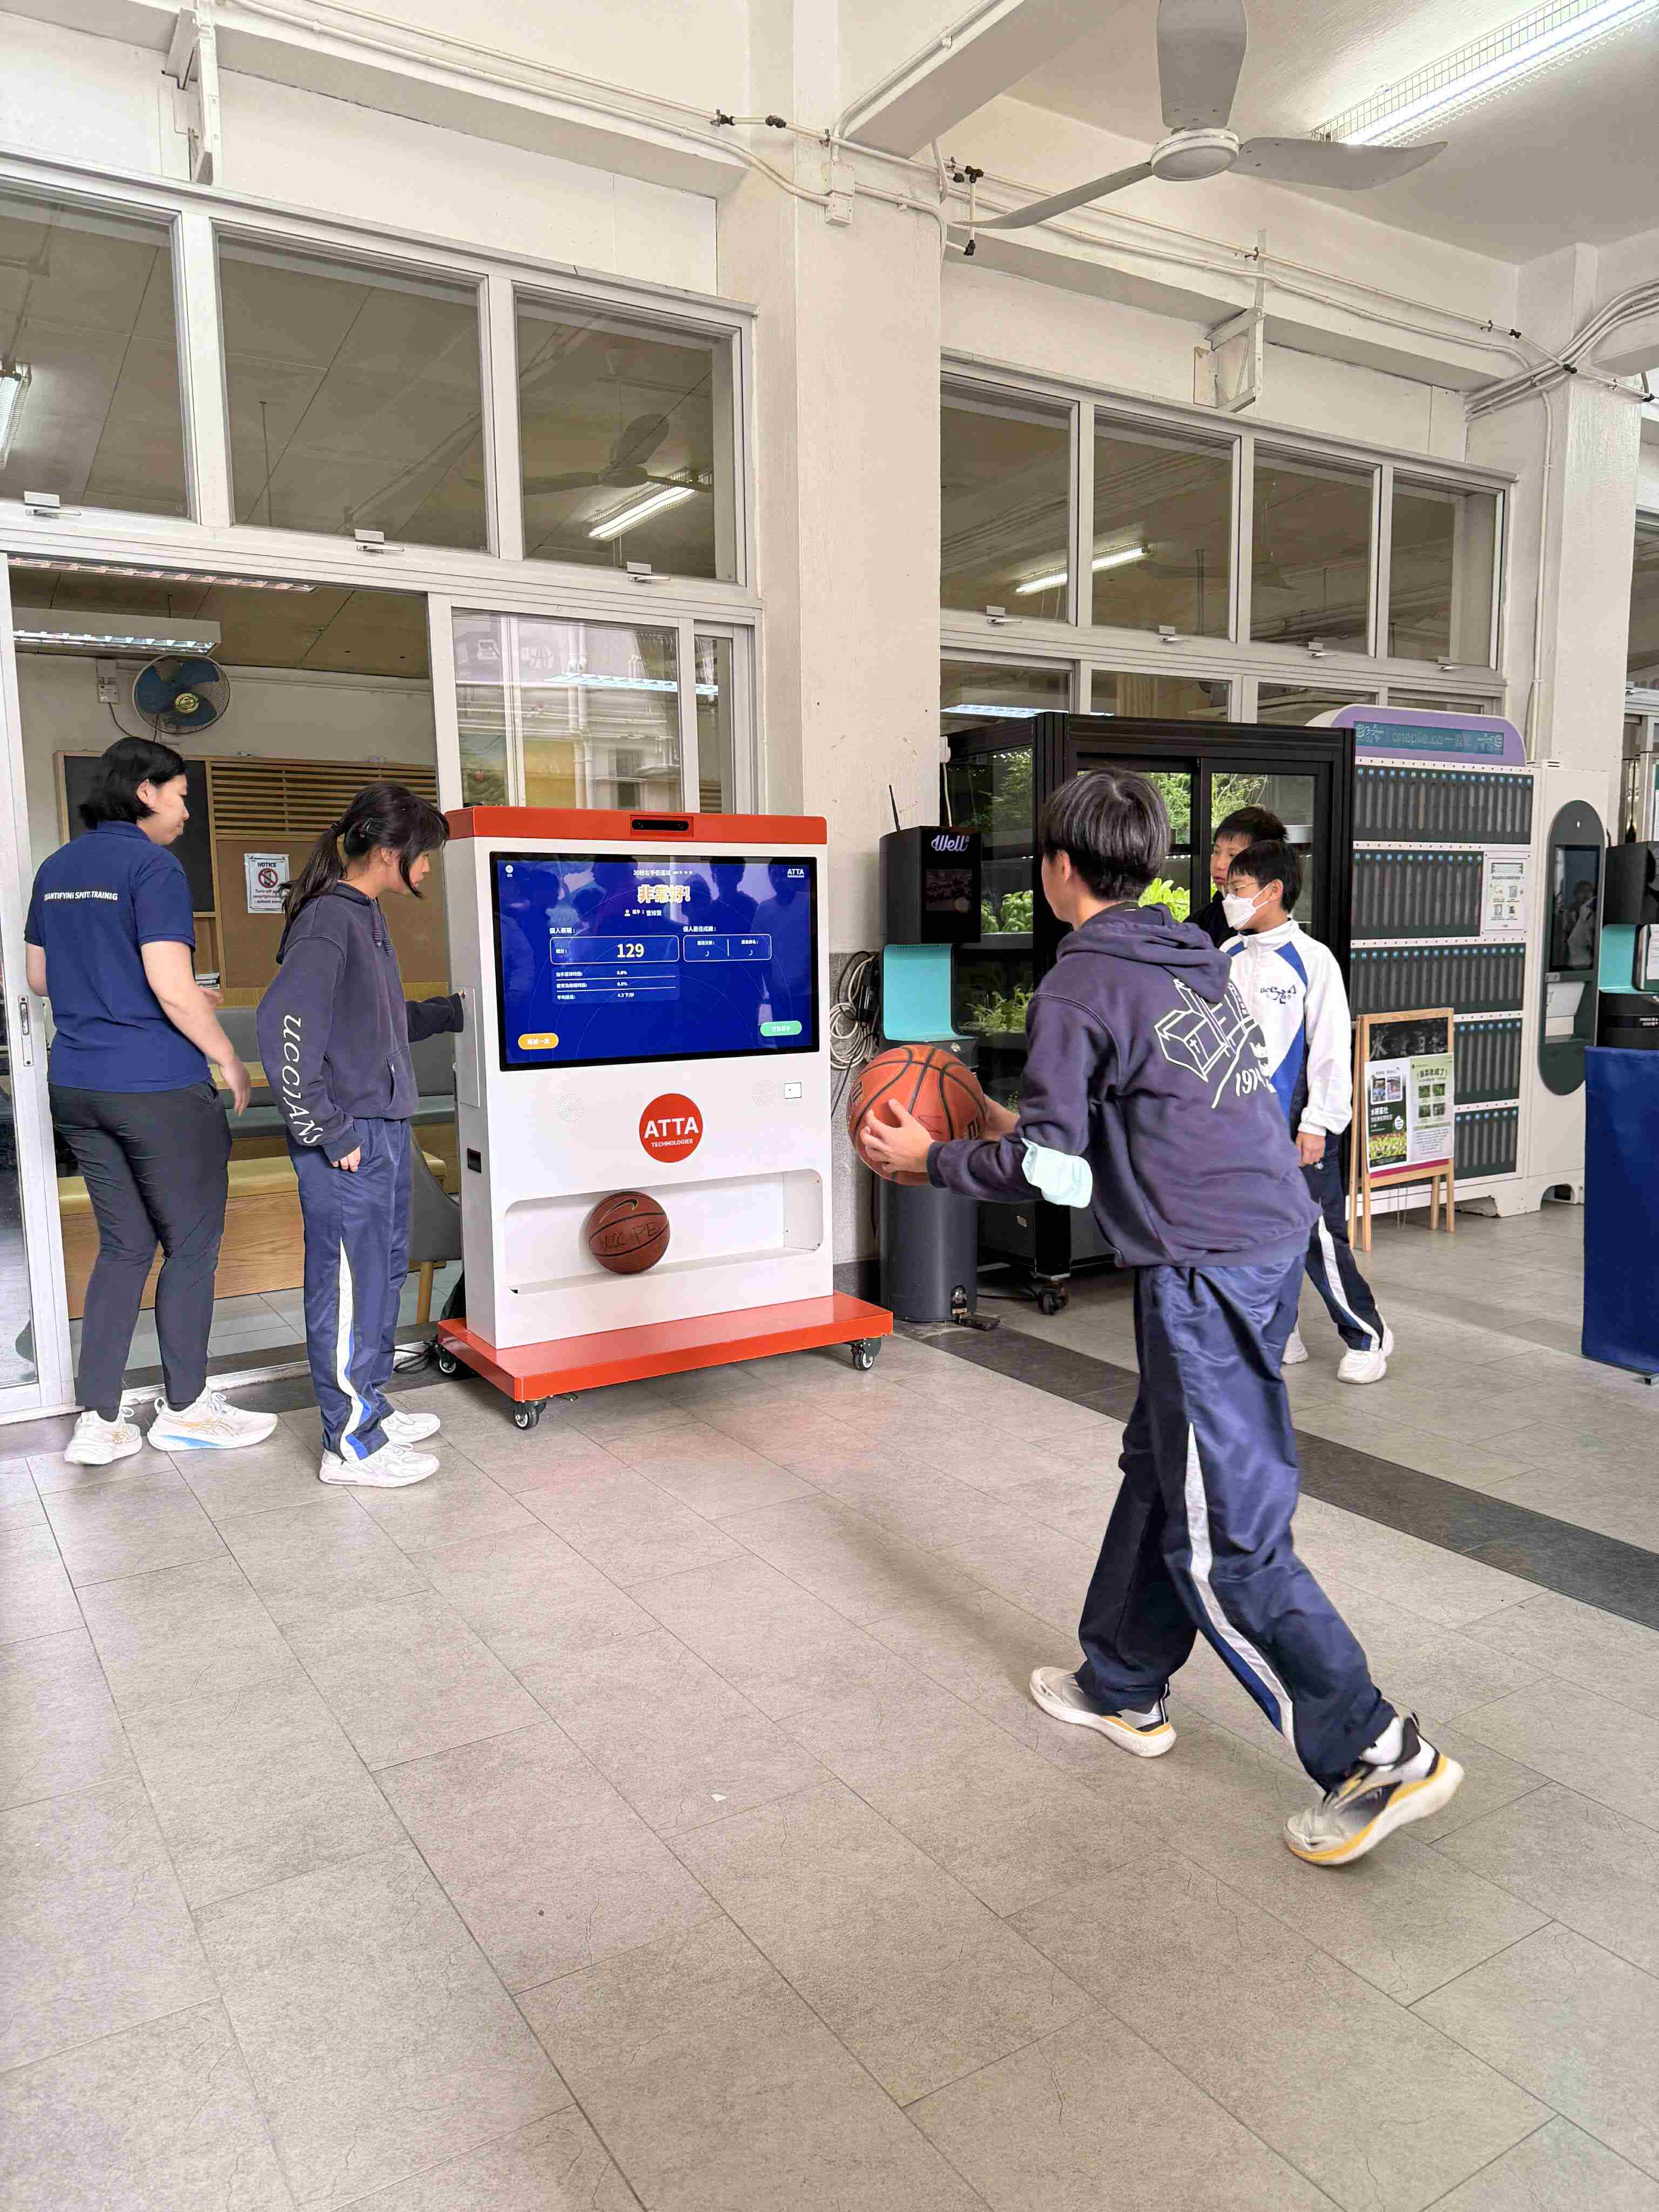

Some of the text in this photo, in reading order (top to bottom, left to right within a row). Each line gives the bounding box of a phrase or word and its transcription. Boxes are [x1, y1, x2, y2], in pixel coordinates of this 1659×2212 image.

[617, 943, 644, 958] 129
[282, 1015, 323, 1144] UCCIANS
[644, 1116, 699, 1139] ATTA
[651, 1138, 693, 1148] TECHNOLOGIES
